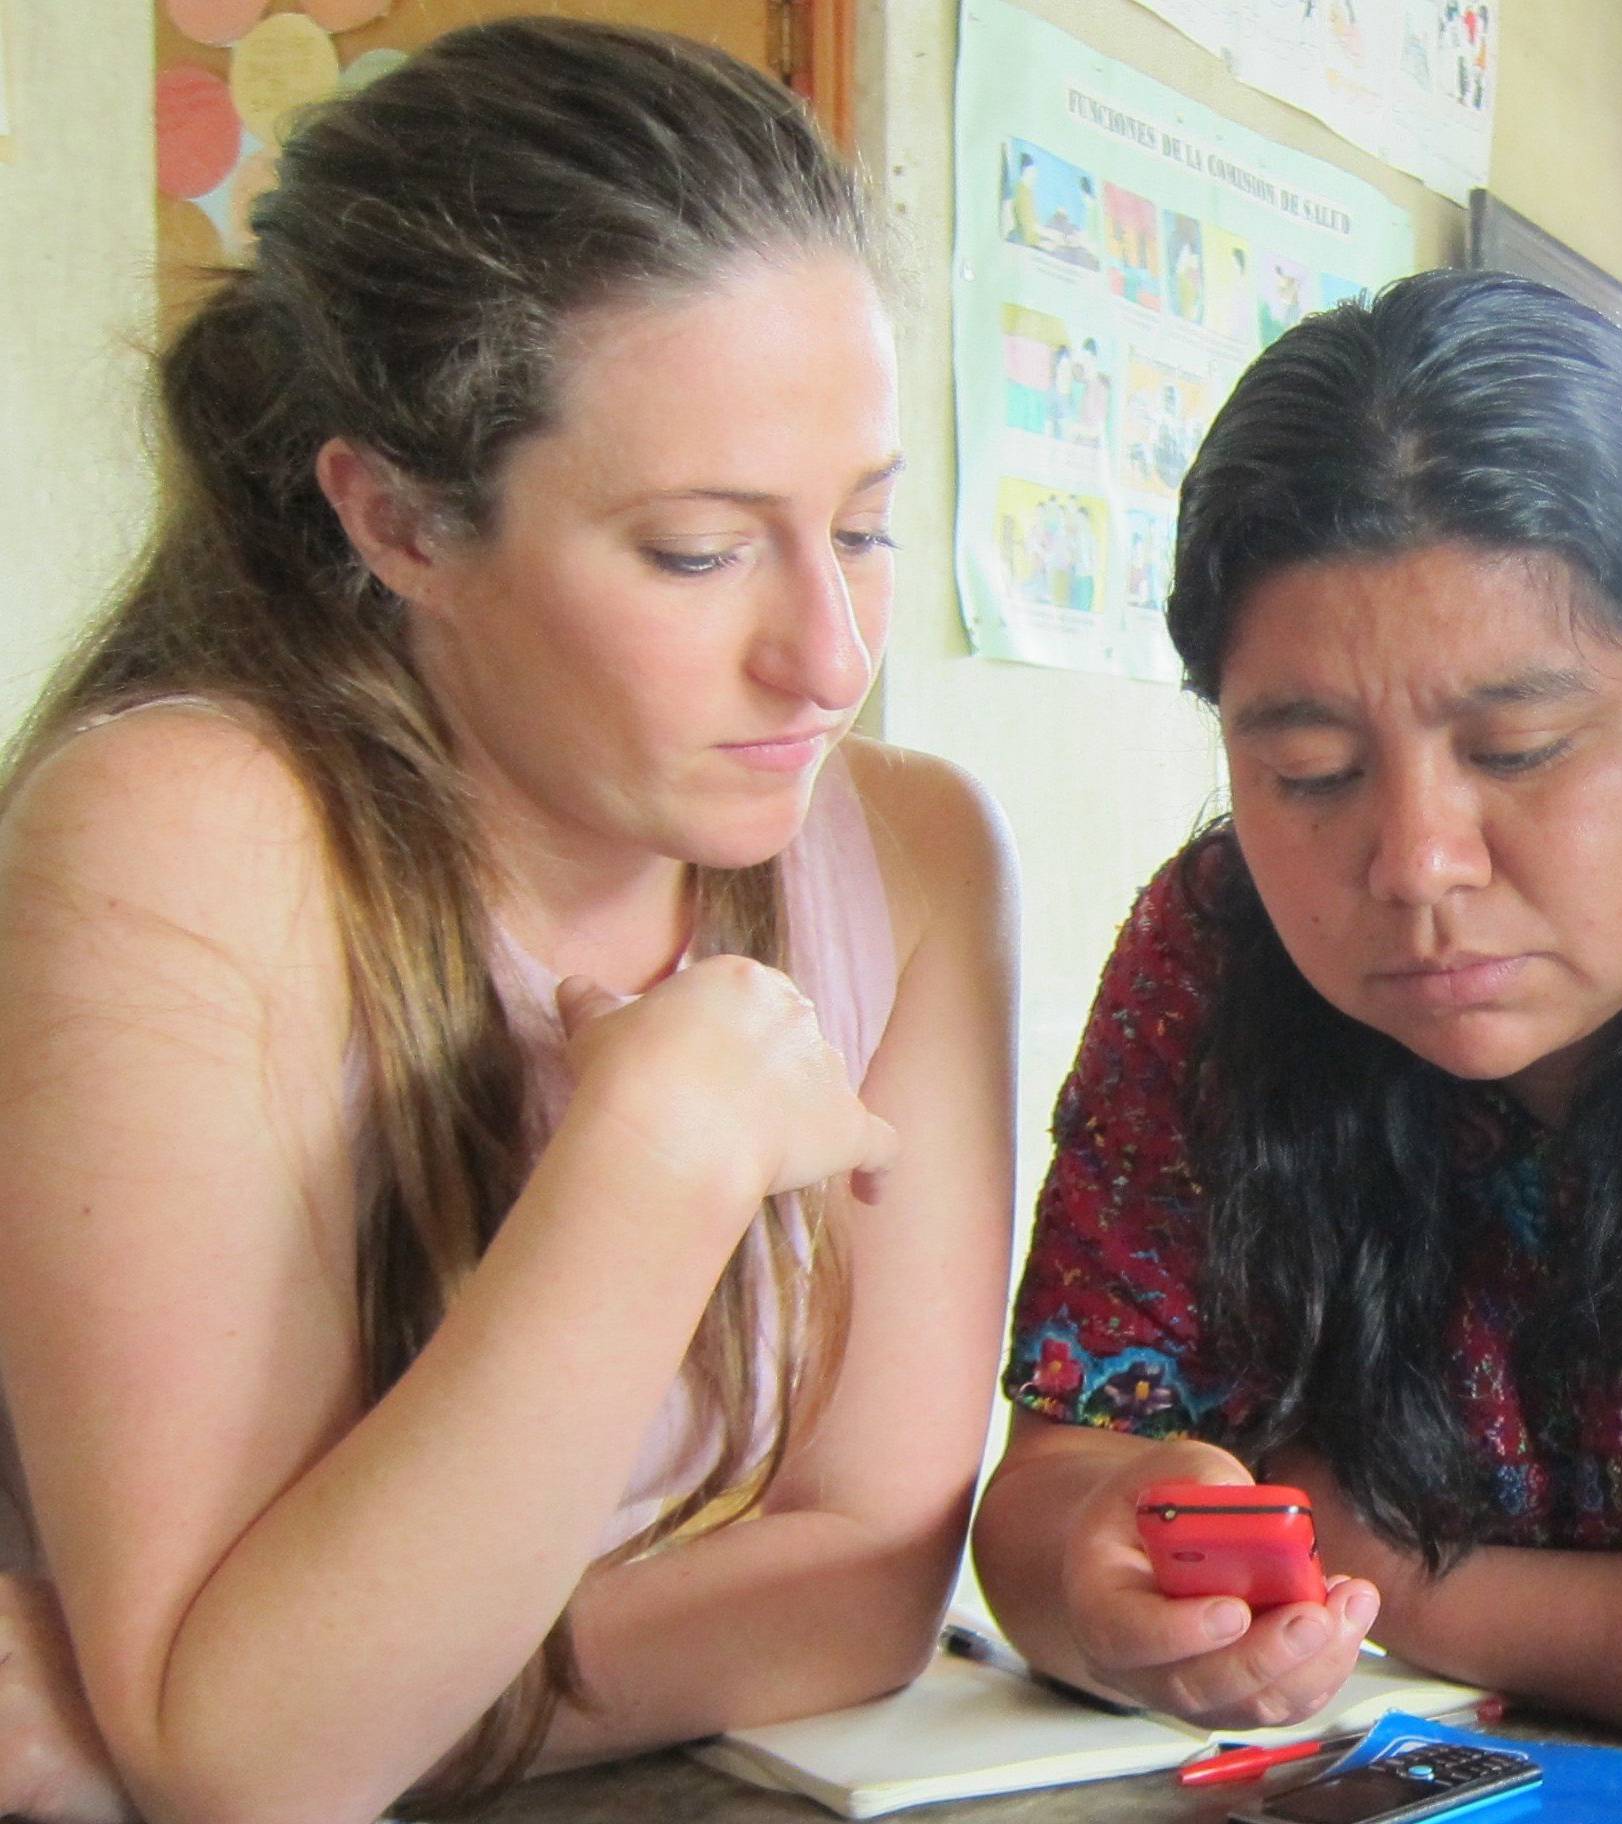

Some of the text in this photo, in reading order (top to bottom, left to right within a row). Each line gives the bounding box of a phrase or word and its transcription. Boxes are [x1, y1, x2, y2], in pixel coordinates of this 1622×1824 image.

[1068, 88, 1157, 150] FUNCIONES
[1161, 132, 1184, 162] DE
[1185, 143, 1202, 171] LA
[1280, 189, 1300, 216] DE
[1303, 199, 1351, 235] SALUD
